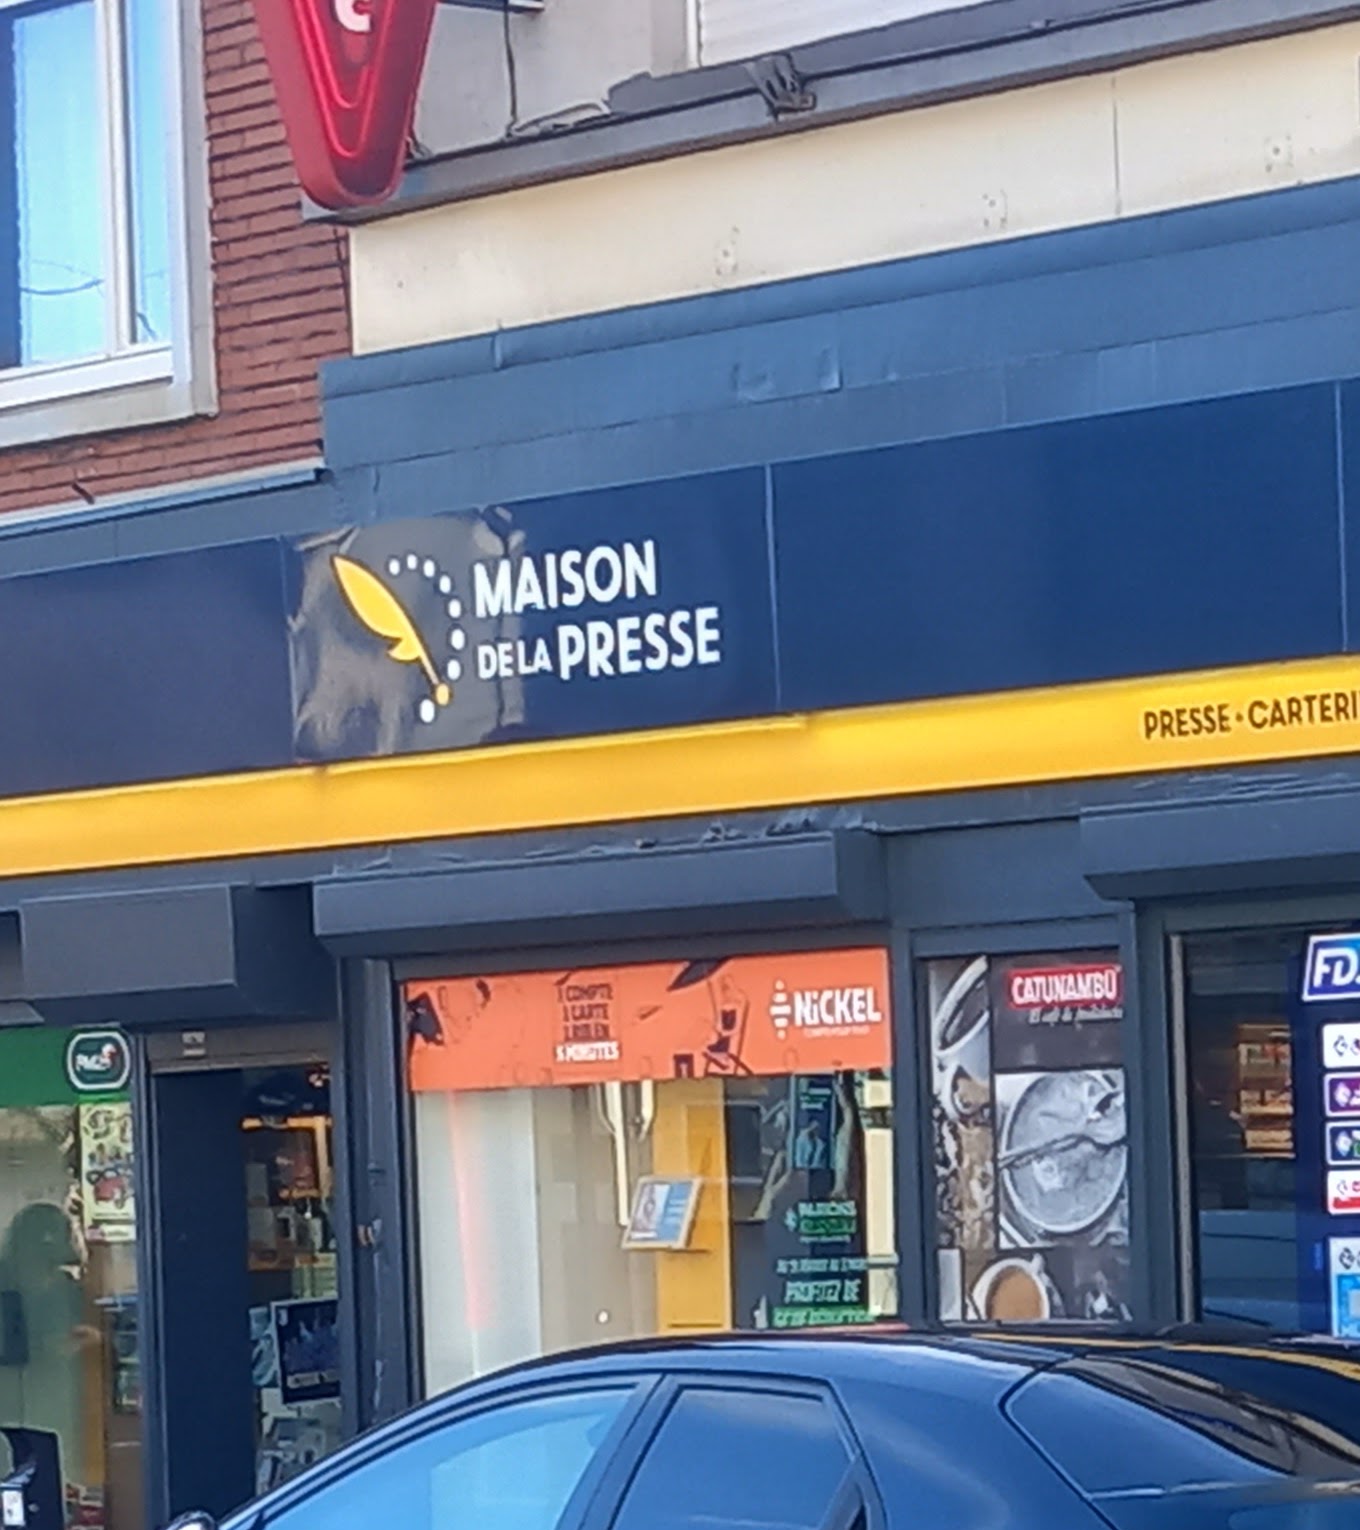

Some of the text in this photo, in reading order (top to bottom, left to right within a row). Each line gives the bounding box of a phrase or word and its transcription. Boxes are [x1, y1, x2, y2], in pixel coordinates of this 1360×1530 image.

[474, 540, 657, 618] MAISON
[477, 607, 720, 680] DE LA PRESSE
[1143, 704, 1232, 739] PRESSE
